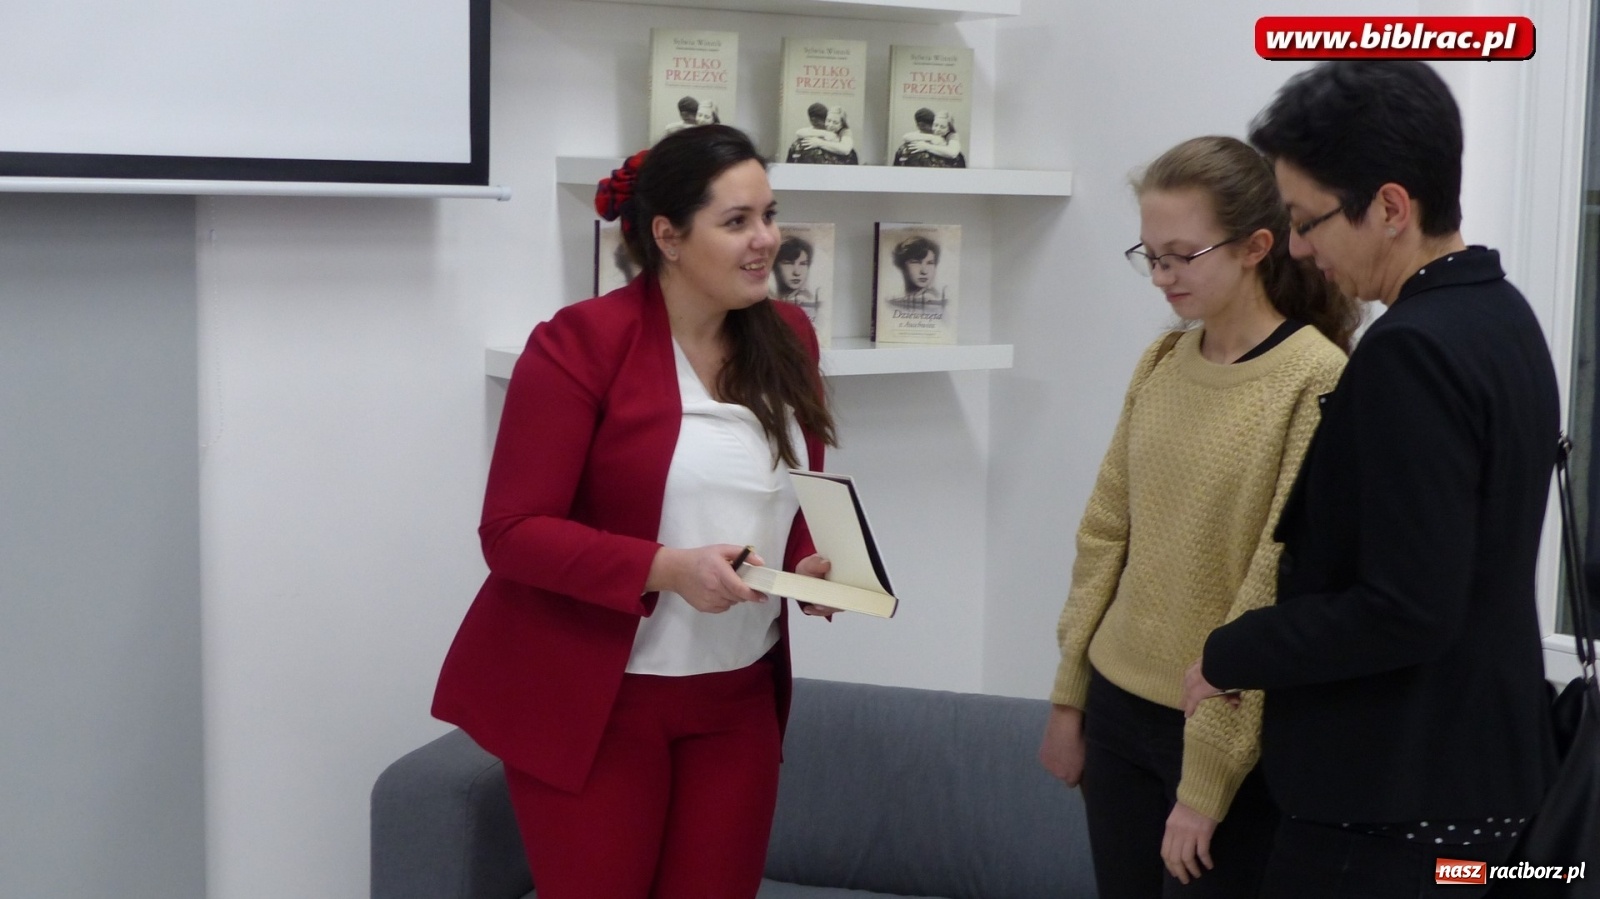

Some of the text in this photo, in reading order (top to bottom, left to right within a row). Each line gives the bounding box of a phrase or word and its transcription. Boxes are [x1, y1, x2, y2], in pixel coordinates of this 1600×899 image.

[673, 57, 721, 69] TYLKO
[803, 65, 850, 77] TYLKO
[910, 71, 957, 83] TYLKO
